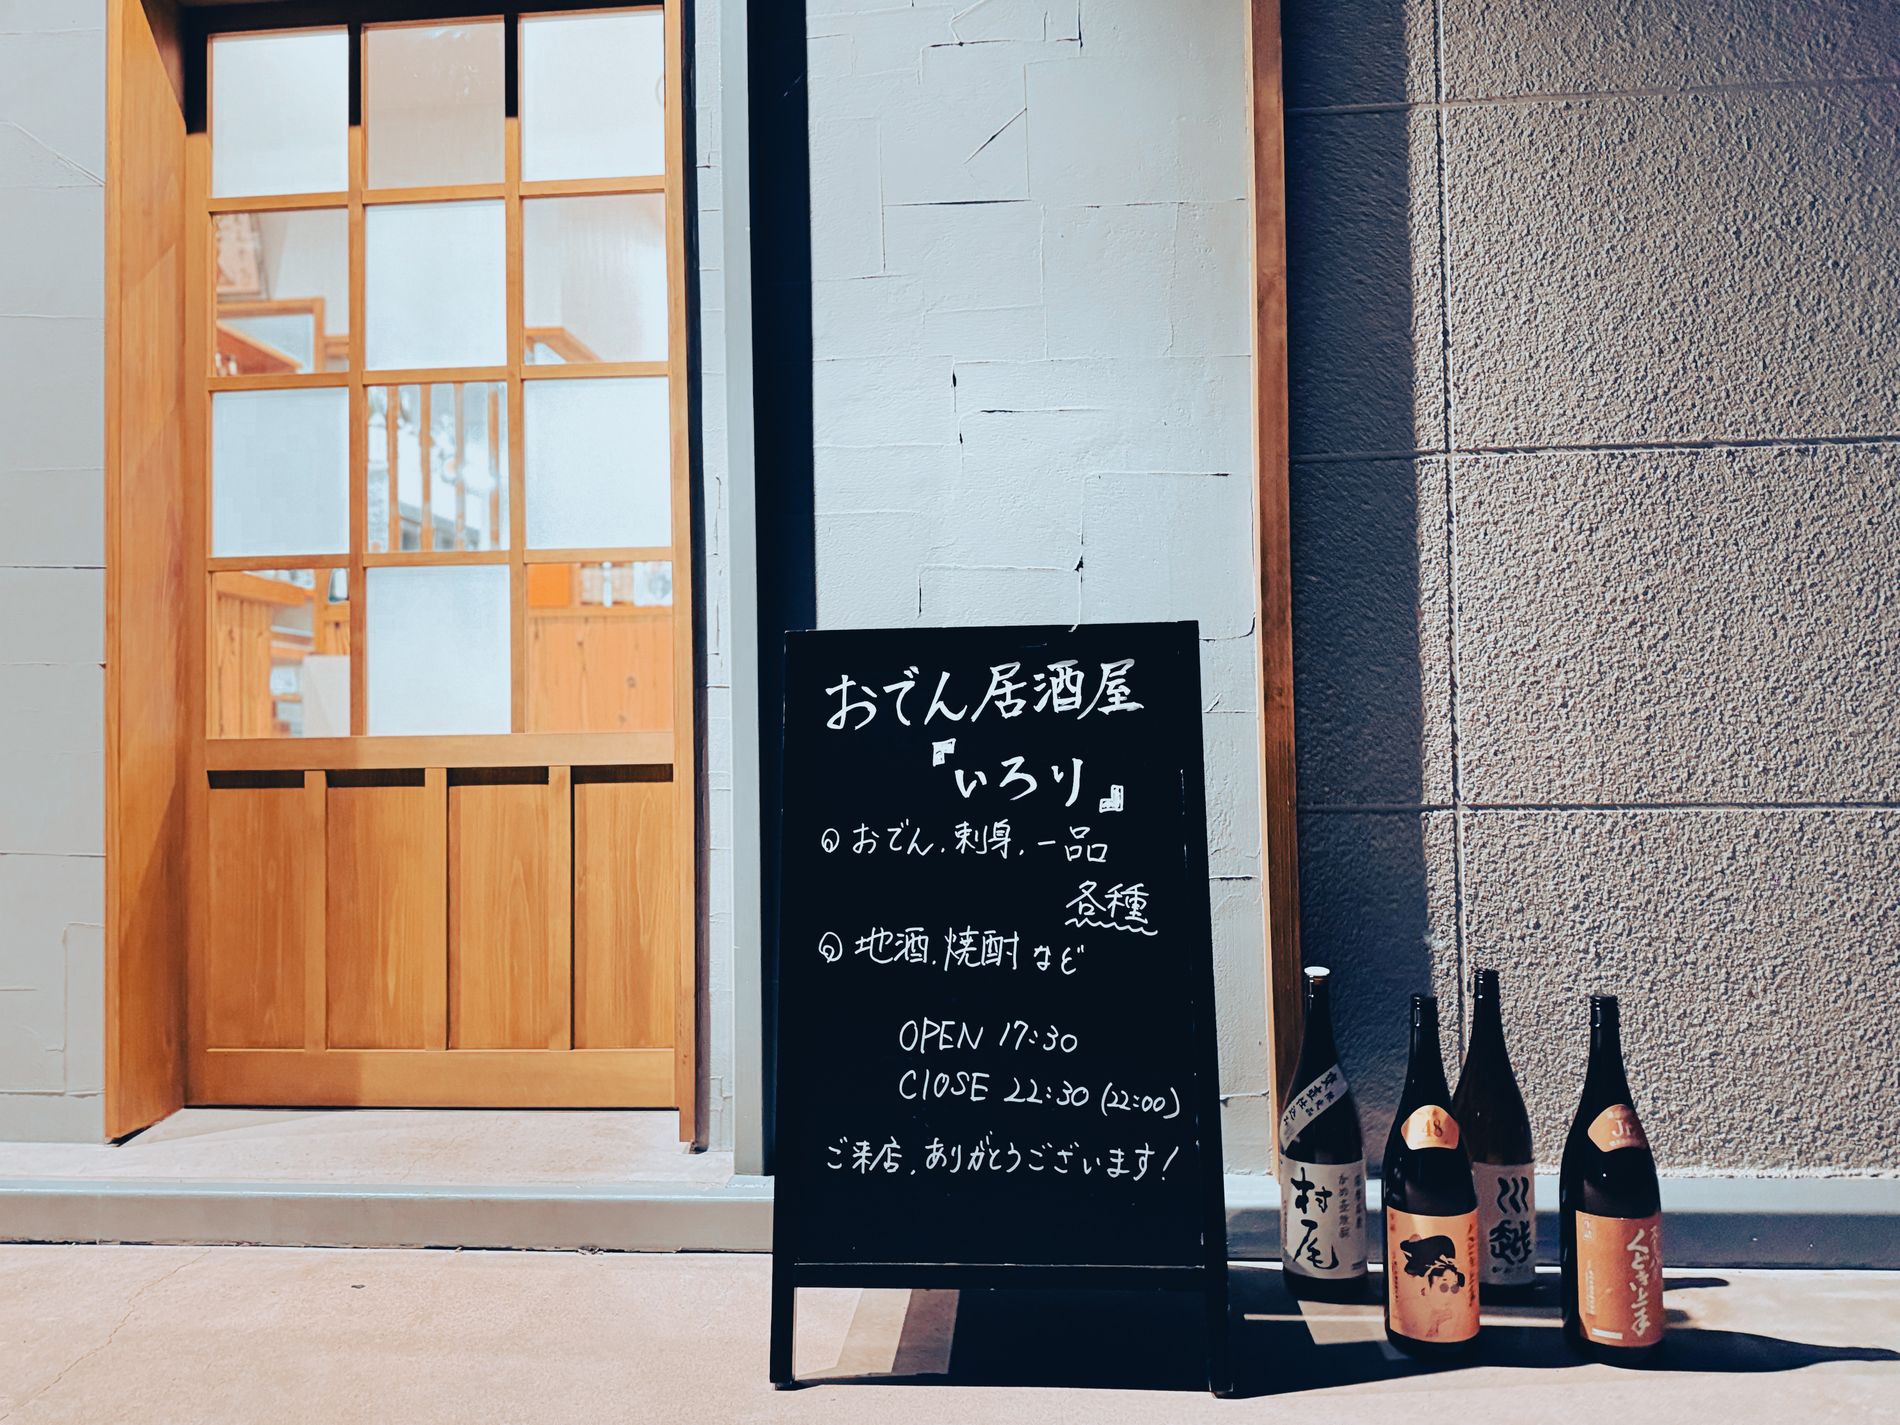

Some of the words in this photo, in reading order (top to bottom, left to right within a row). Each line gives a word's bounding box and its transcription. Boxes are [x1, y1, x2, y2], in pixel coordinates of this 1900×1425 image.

[826, 659, 1145, 731] おでん居酒屋
[1064, 879, 1150, 926] 各種
[899, 1016, 984, 1054] OPEN
[999, 1020, 1078, 1053] 17:30
[898, 1068, 990, 1103] CLOSE
[1003, 1077, 1090, 1108] 22:30
[1101, 1081, 1181, 1120] (22:00)
[1290, 1166, 1340, 1270] 村尾
